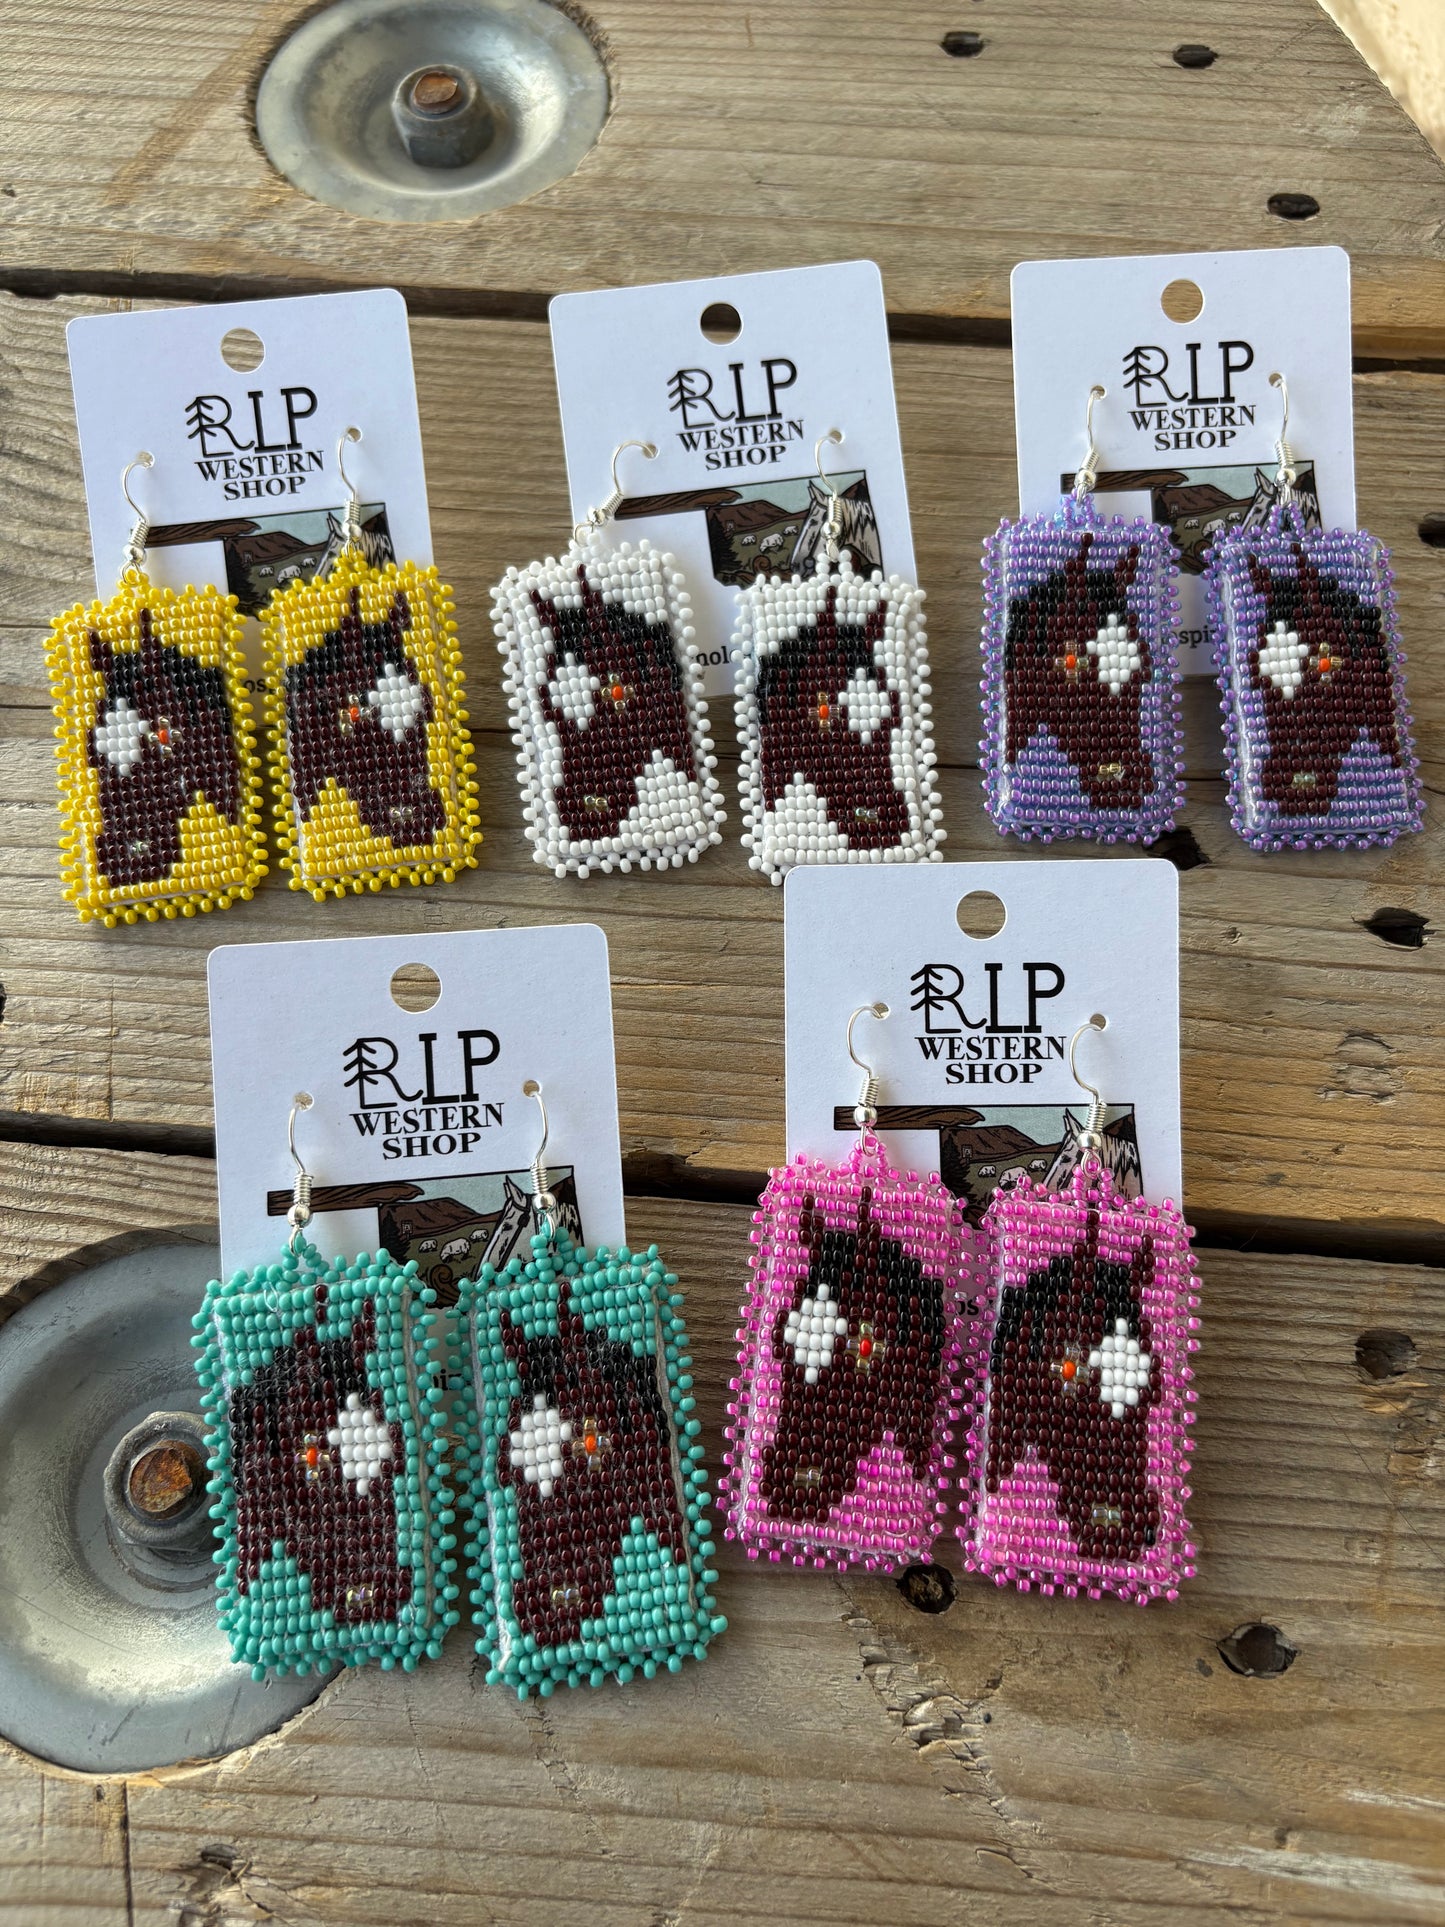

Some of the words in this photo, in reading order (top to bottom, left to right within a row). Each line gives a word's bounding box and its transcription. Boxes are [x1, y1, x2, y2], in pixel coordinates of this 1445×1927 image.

[1122, 341, 1254, 408] RLP
[666, 358, 798, 430] RLP
[184, 386, 318, 459] RLP
[1127, 404, 1257, 431] WESTERN
[676, 419, 804, 453] WESTERN
[1154, 429, 1237, 452] SHOP
[194, 450, 324, 482] WESTERN
[705, 445, 787, 471] SHOP
[224, 476, 306, 501] SHOP
[910, 962, 1066, 1034] RLP
[914, 1035, 1068, 1061] WESTERN
[342, 1029, 501, 1109] RLP
[945, 1062, 1043, 1085] SHOP
[349, 1102, 505, 1137] WESTERN
[382, 1132, 482, 1160] SHOP
